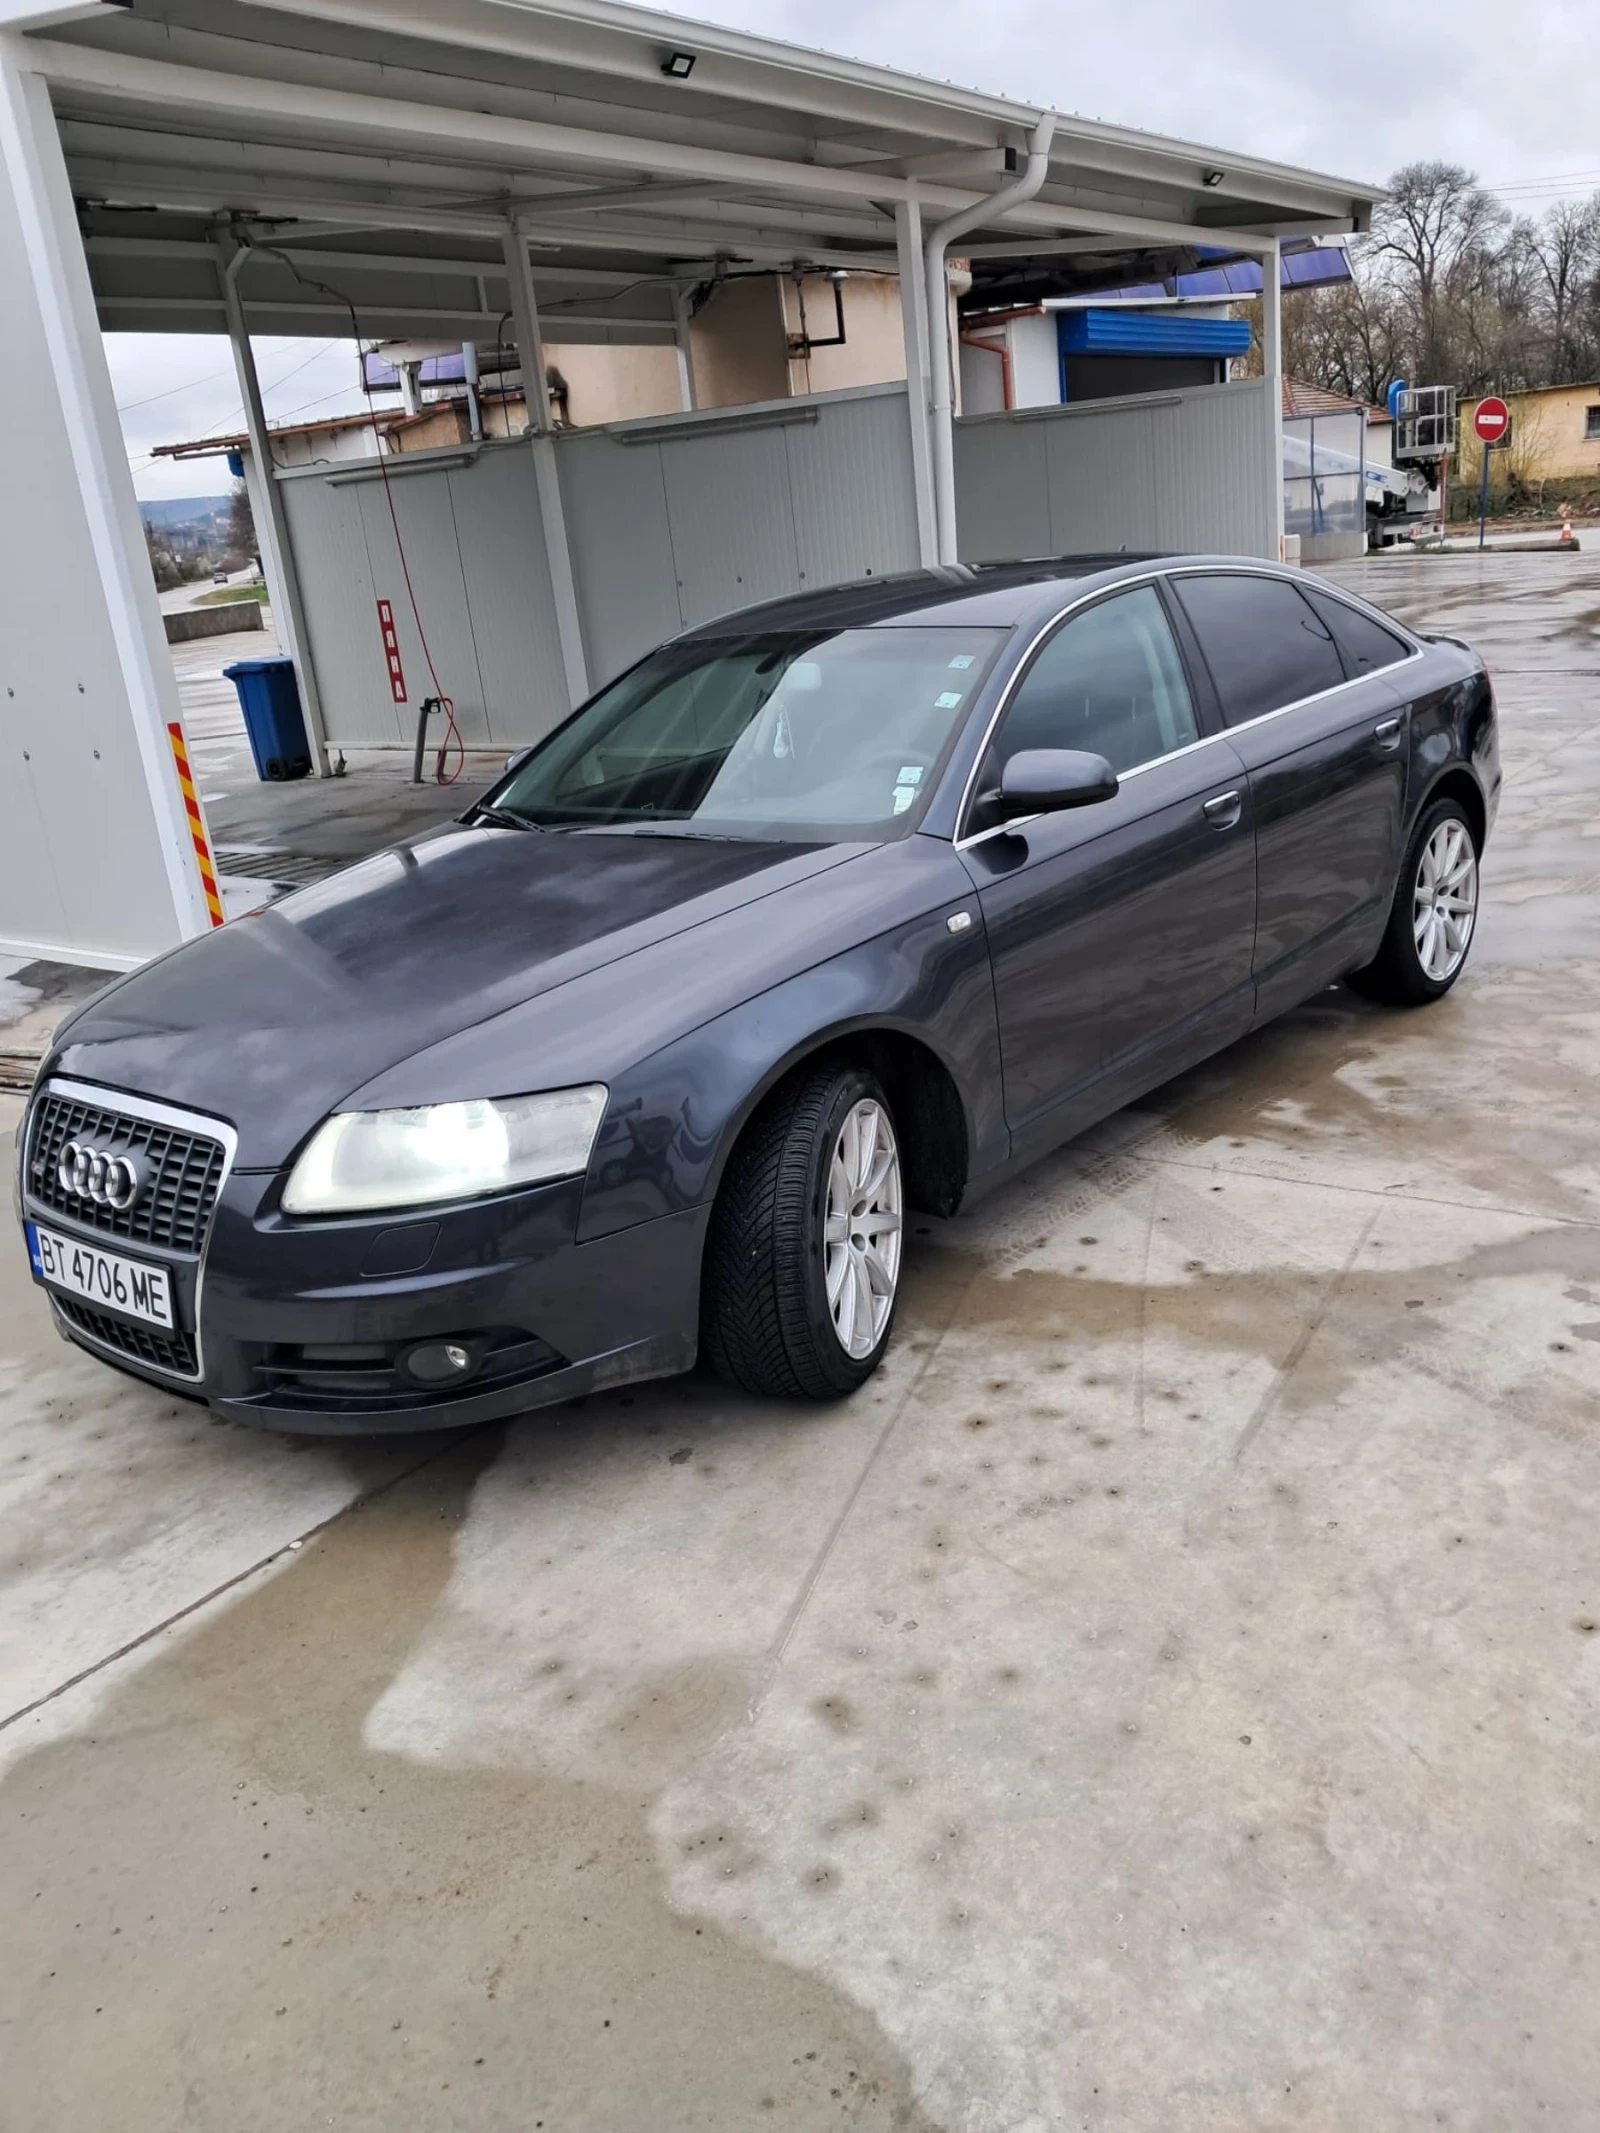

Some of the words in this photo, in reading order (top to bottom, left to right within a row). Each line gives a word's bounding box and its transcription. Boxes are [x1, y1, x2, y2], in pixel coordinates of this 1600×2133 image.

[381, 604, 404, 698] ПЯНА
[40, 1233, 65, 1281] BT
[72, 1248, 127, 1305] 4706
[130, 1267, 167, 1320] ME
